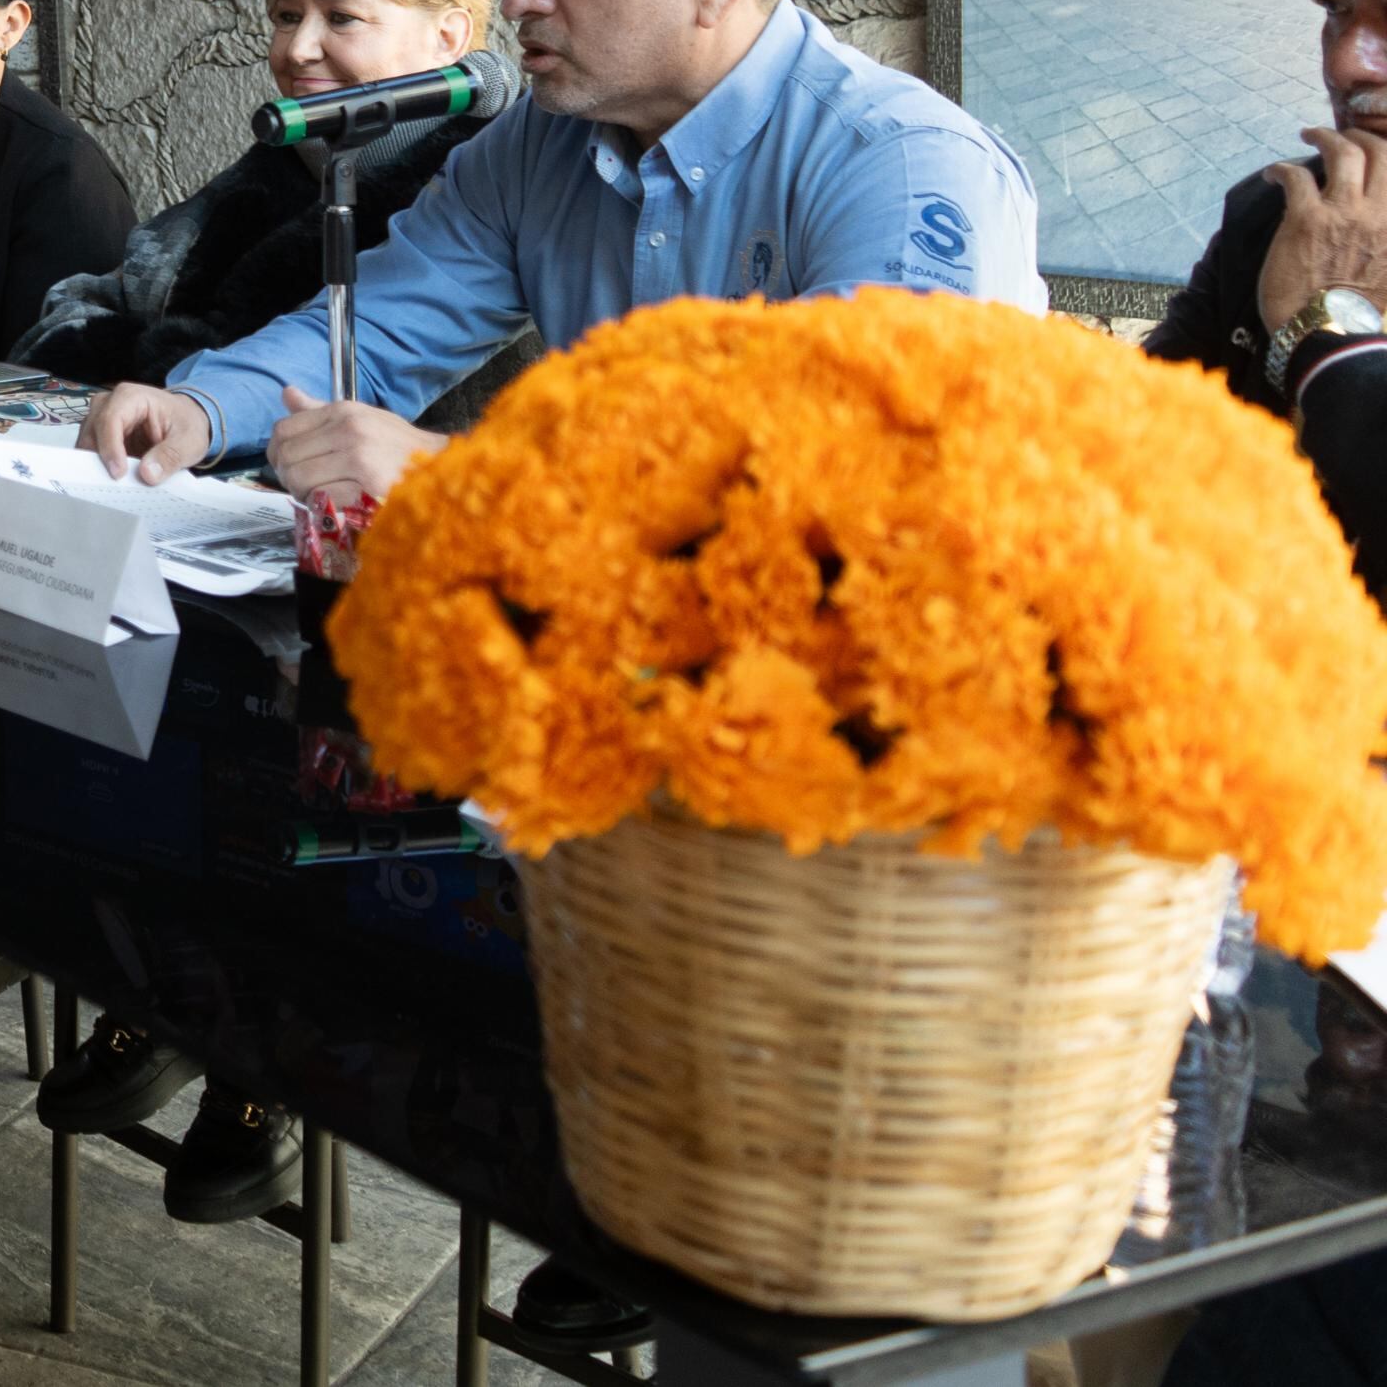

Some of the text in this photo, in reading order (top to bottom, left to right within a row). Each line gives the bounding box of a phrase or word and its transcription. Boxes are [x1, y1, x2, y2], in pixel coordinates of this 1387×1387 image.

[884, 261, 970, 294] SOLIDARIDAD
[20, 546, 56, 568] UGALDE
[45, 575, 95, 602] CIUDADANA
